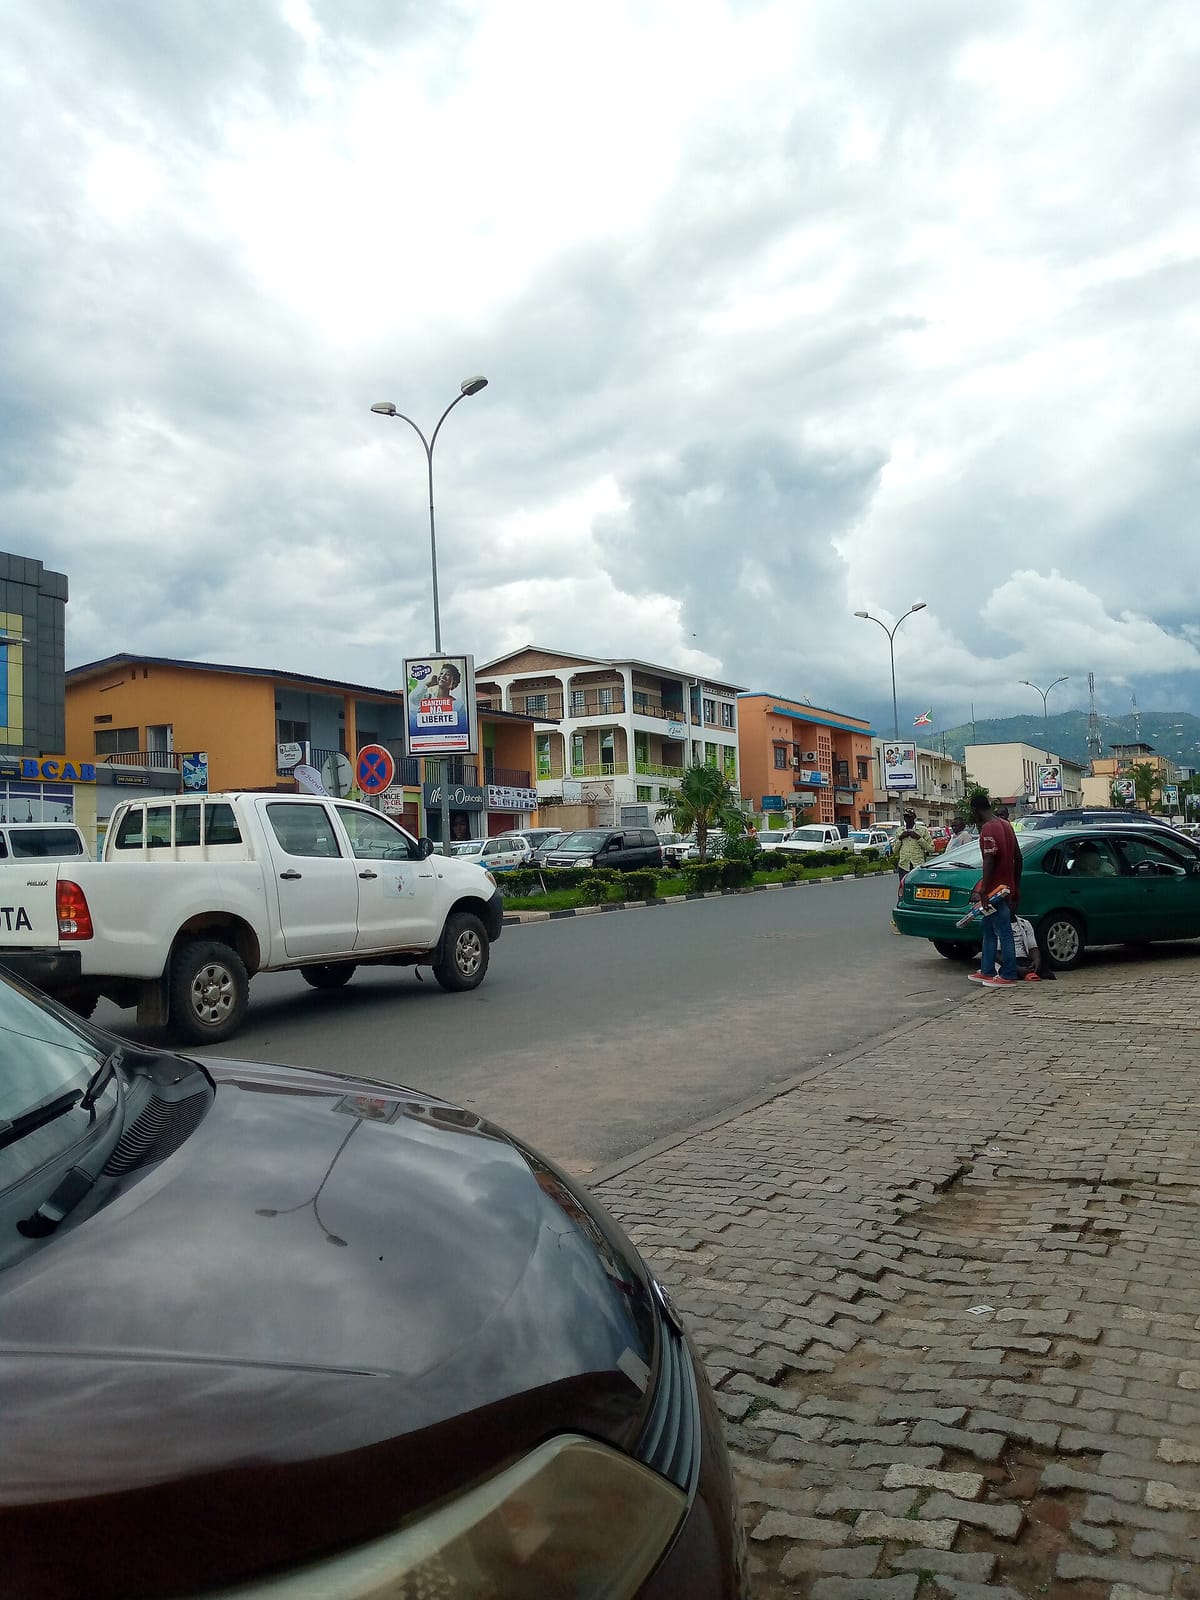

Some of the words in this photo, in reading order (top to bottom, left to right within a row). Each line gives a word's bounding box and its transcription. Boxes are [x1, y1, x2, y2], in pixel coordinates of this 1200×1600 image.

[421, 699, 451, 707] ISANZURE
[430, 706, 443, 714] NA
[421, 714, 454, 724] LIBERTE
[22, 759, 96, 782] BCAB
[0, 906, 33, 931] TA
